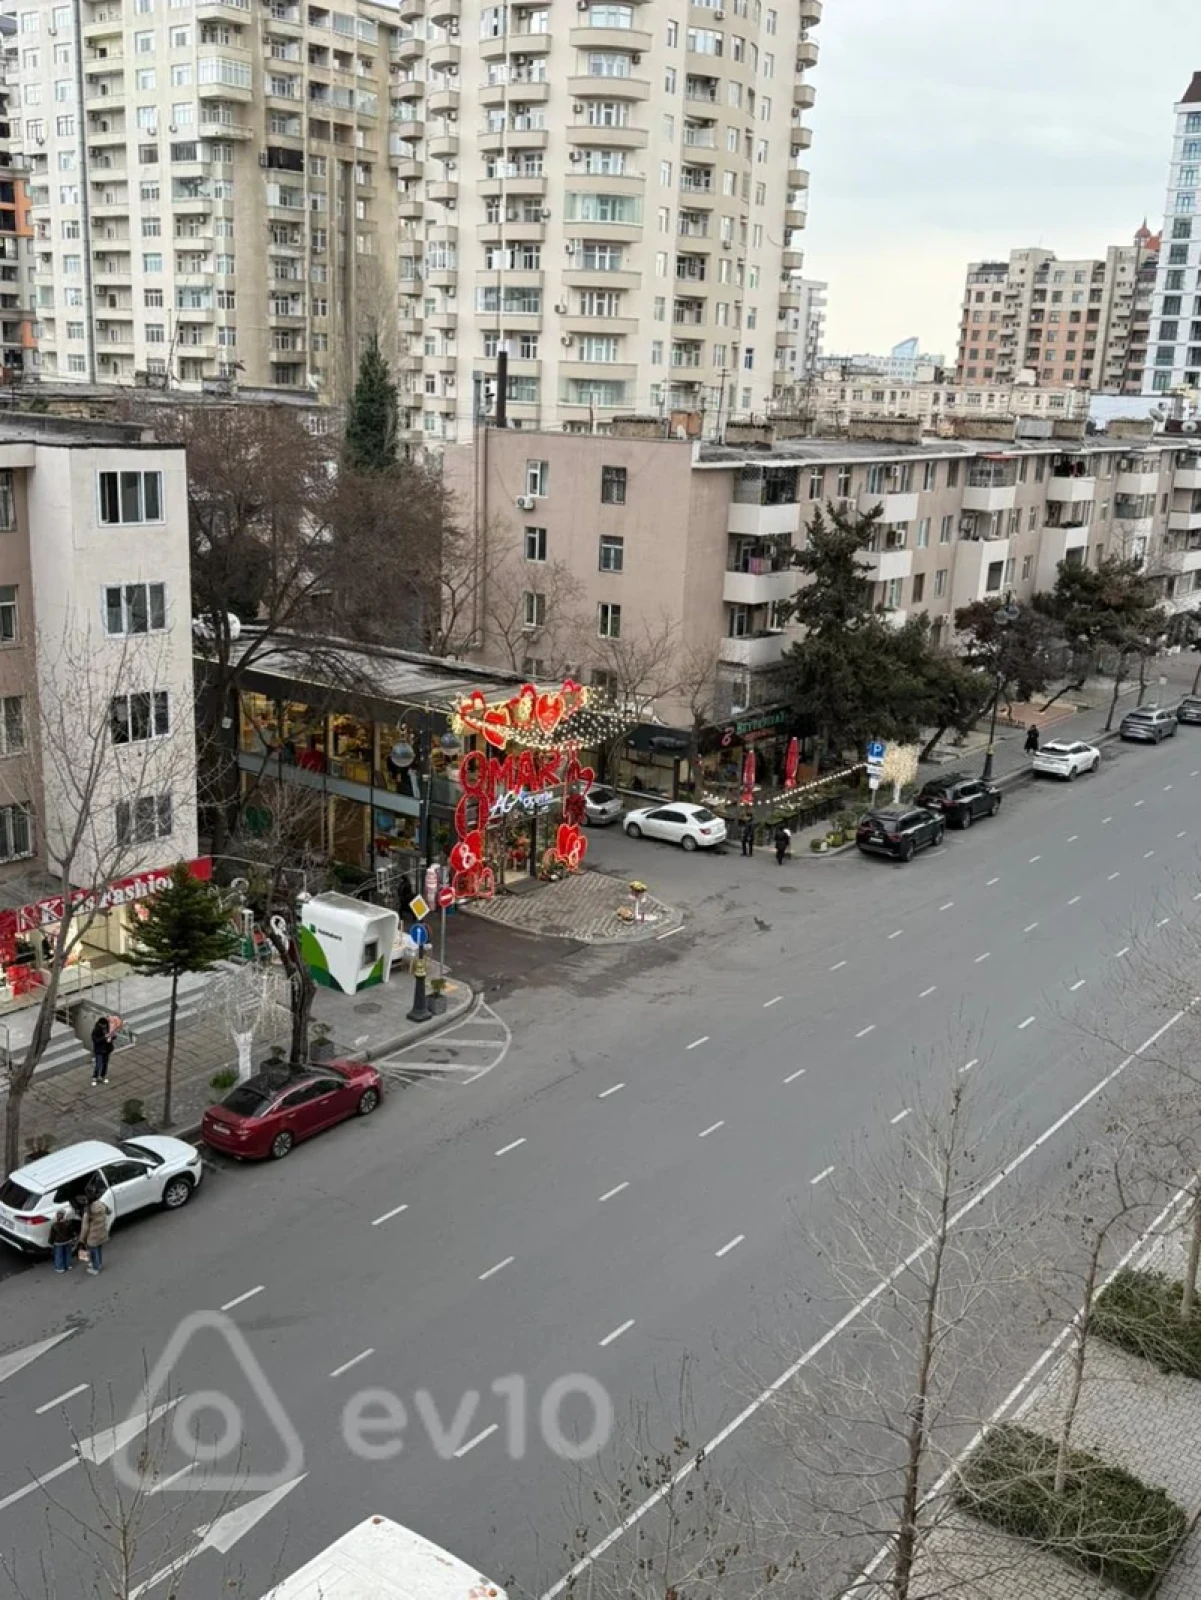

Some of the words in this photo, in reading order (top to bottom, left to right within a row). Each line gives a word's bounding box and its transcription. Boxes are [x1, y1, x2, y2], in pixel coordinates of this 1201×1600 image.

[459, 843, 477, 869] 8
[38, 889, 96, 925] Kds
[99, 874, 173, 908] Fashio
